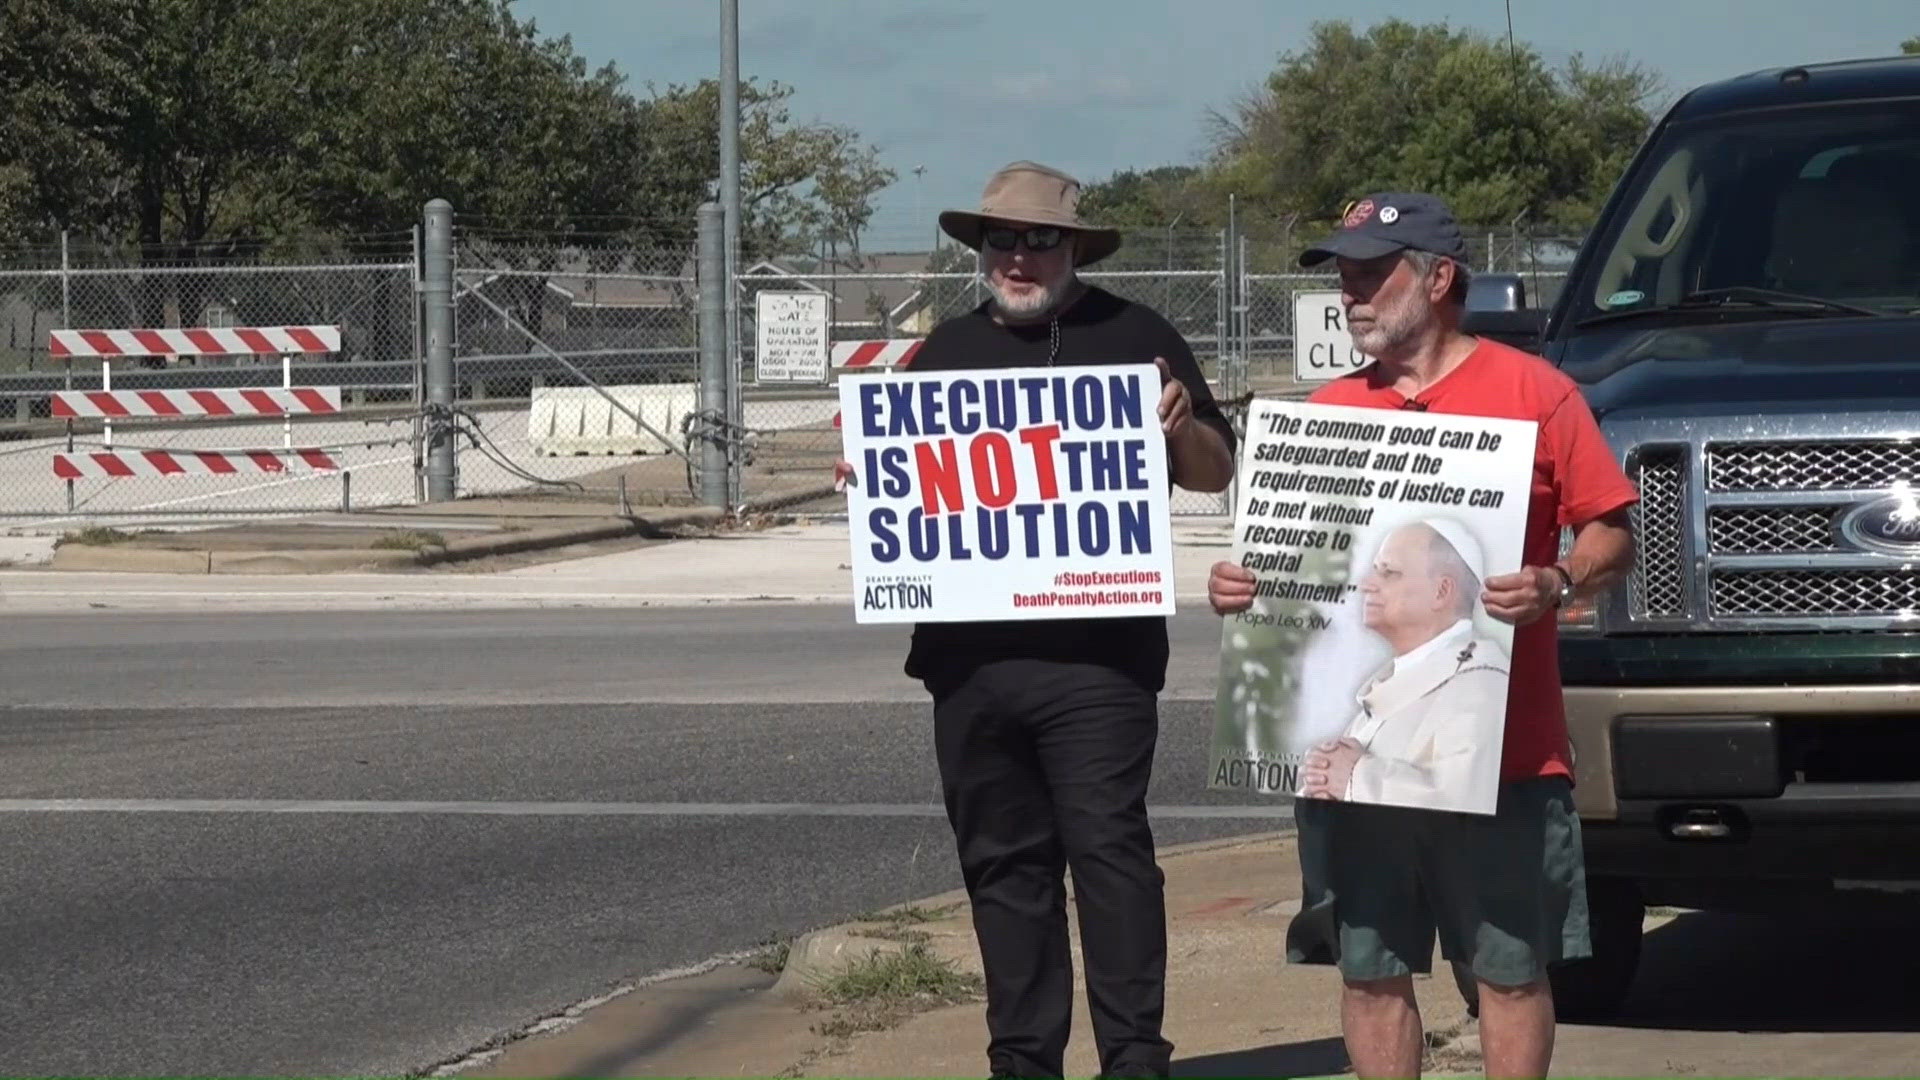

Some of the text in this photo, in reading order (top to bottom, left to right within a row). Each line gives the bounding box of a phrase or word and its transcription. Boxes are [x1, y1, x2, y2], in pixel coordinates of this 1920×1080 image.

[1309, 343, 1365, 368] CLO
[859, 374, 1143, 438] EXECUTION
[1260, 412, 1502, 452] “The common good can be
[864, 424, 1149, 516] IS NOT THE
[1253, 441, 1443, 475] safeguarded and the
[1249, 469, 1505, 509] requirements of justice can
[1246, 496, 1375, 527] be met without
[869, 500, 1152, 564] SOLUTION
[1243, 523, 1352, 551] recourse to
[1241, 550, 1304, 573] capital
[1054, 570, 1162, 587] #StopExecutions
[863, 584, 933, 610] ACTION
[1013, 590, 1163, 608] DeathPenaltyAction.org
[1236, 610, 1333, 630] Pope Leo XIV
[1214, 758, 1299, 792] ACTION
